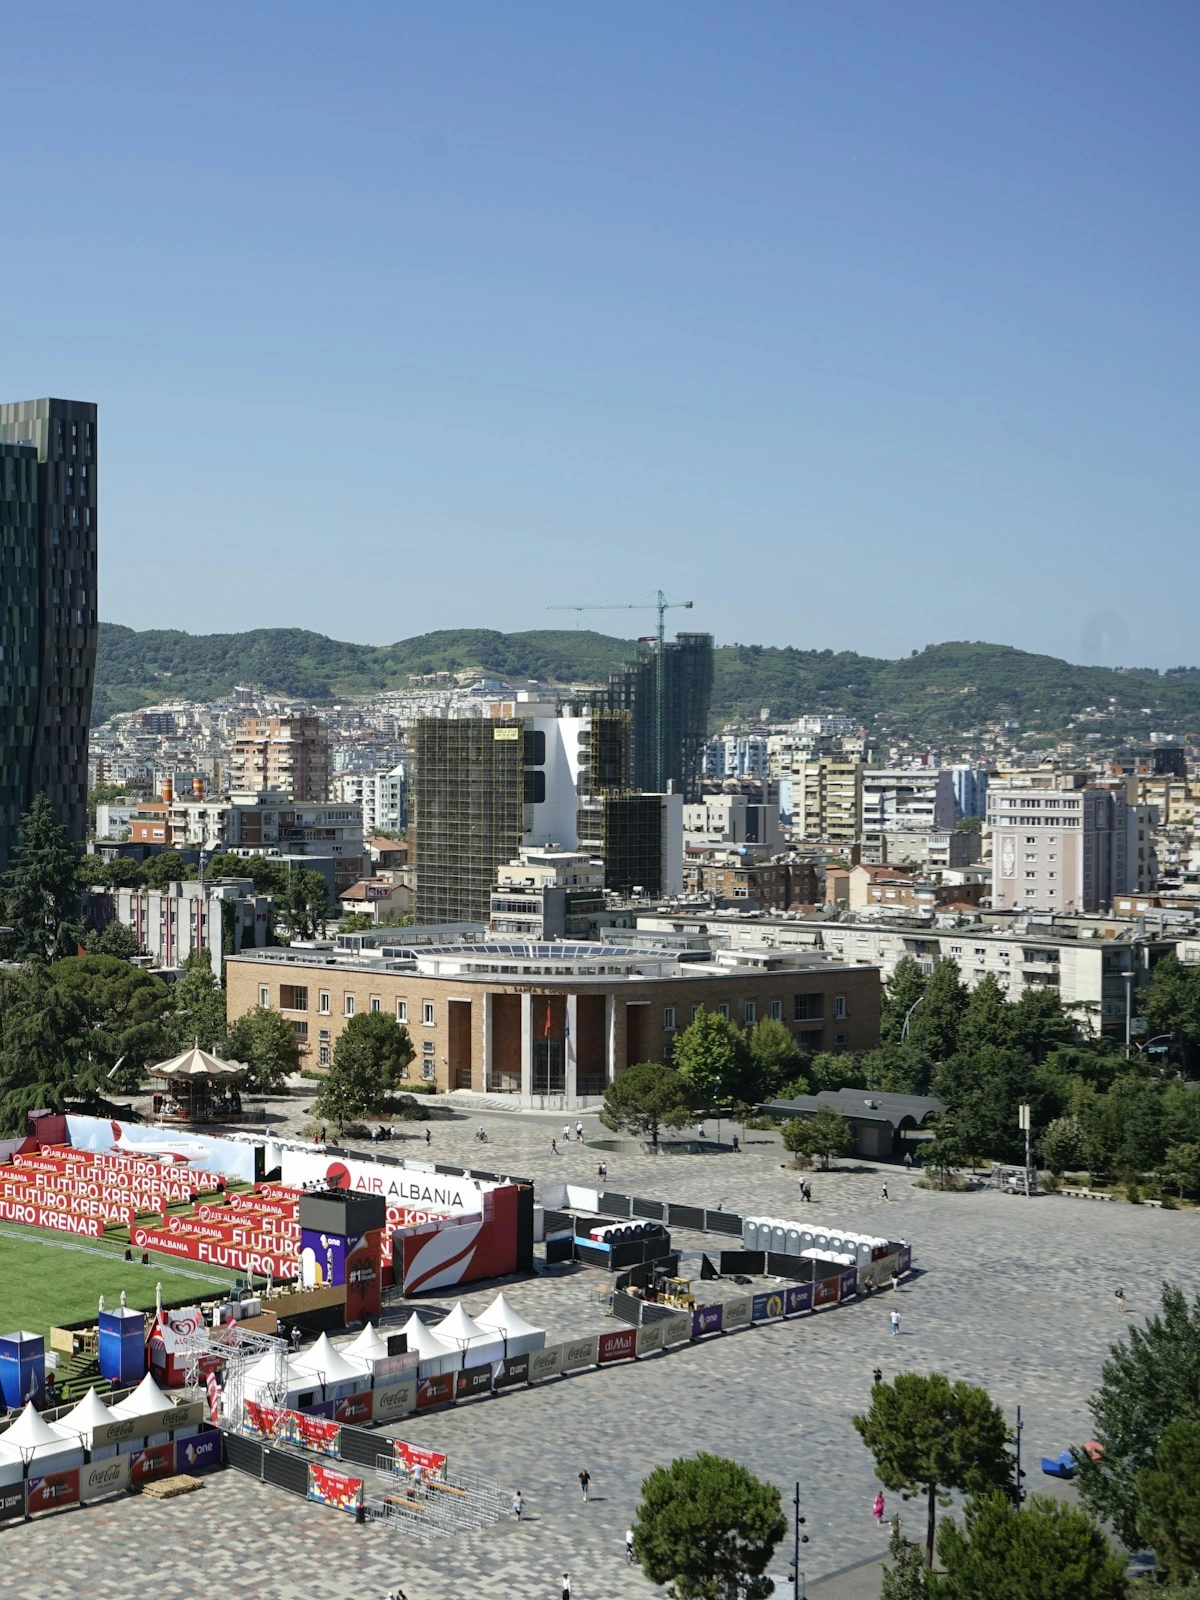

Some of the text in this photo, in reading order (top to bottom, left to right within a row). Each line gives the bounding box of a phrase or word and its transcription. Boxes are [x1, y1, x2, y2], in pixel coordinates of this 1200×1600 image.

[60, 1151, 86, 1163] ALBANIA
[93, 1154, 157, 1177] FLUTURO
[161, 1166, 220, 1189] KRENAR
[32, 1160, 57, 1172] ALBANIA
[65, 1164, 128, 1188] FLUTURO
[132, 1176, 192, 1201] KRENAR
[2, 1171, 28, 1182] ALBANIA
[35, 1173, 99, 1199] FLUTURO
[102, 1187, 161, 1212] KRENAR
[272, 1190, 300, 1202] AIR ALBA
[355, 1175, 464, 1208] AIR ALBANIA
[4, 1184, 67, 1210] FLUTURO
[70, 1198, 130, 1224] KRENAR
[241, 1200, 253, 1210] AIR
[253, 1202, 283, 1215] ALBANIA
[39, 1209, 98, 1236] KRENAR
[210, 1211, 301, 1239] AIR ALBANIA FLUT
[180, 1223, 193, 1232] AIR
[193, 1225, 223, 1238] ALBANIA
[328, 1238, 341, 1247] one
[147, 1236, 159, 1245] AIR
[159, 1238, 189, 1252] ALBANIA
[198, 1243, 275, 1275] FLUTURO
[350, 1269, 360, 1283] #1
[796, 1292, 808, 1301] one
[705, 1313, 718, 1323] one
[427, 1386, 437, 1397] #1
[345, 1407, 355, 1417] #1
[196, 1441, 213, 1455] one
[142, 1458, 154, 1472] #1
[42, 1486, 56, 1499] #1
